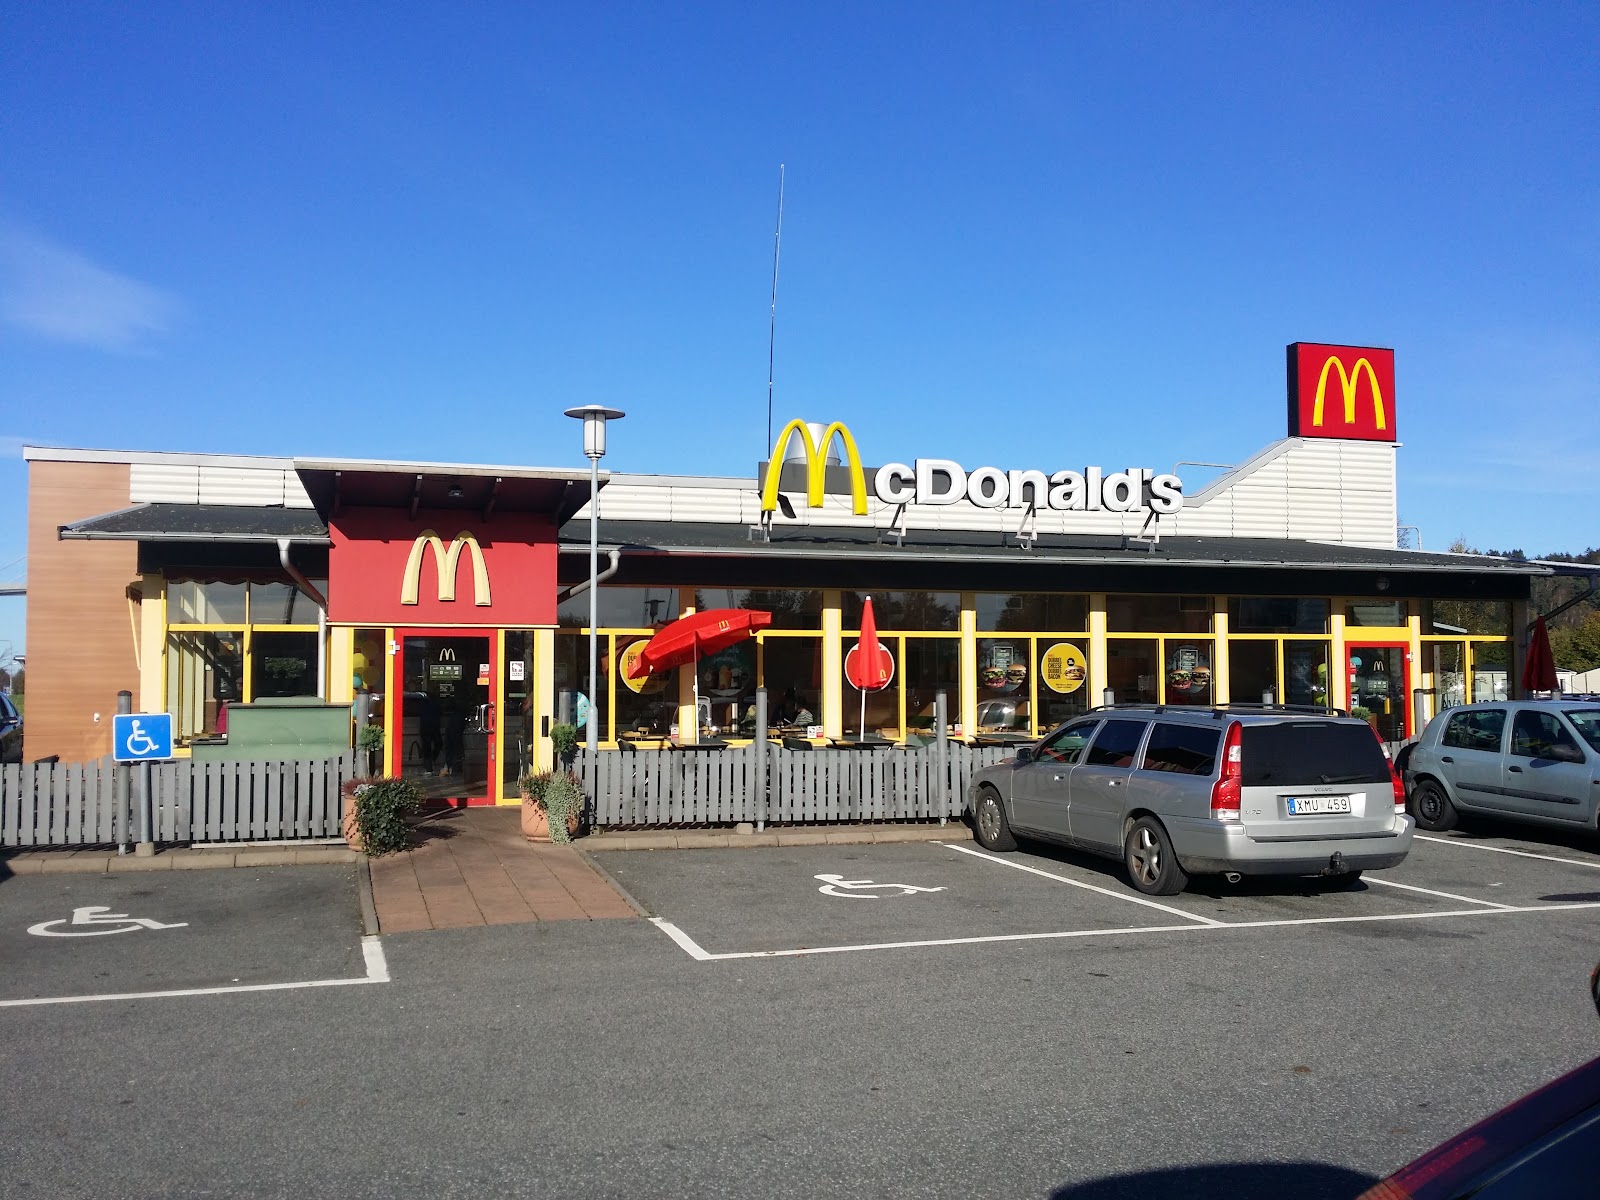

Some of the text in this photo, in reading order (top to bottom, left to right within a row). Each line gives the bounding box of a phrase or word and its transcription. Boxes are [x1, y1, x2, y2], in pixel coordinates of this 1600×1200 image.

[761, 418, 1183, 516] McDonald's
[1296, 798, 1348, 812] XMU 459
